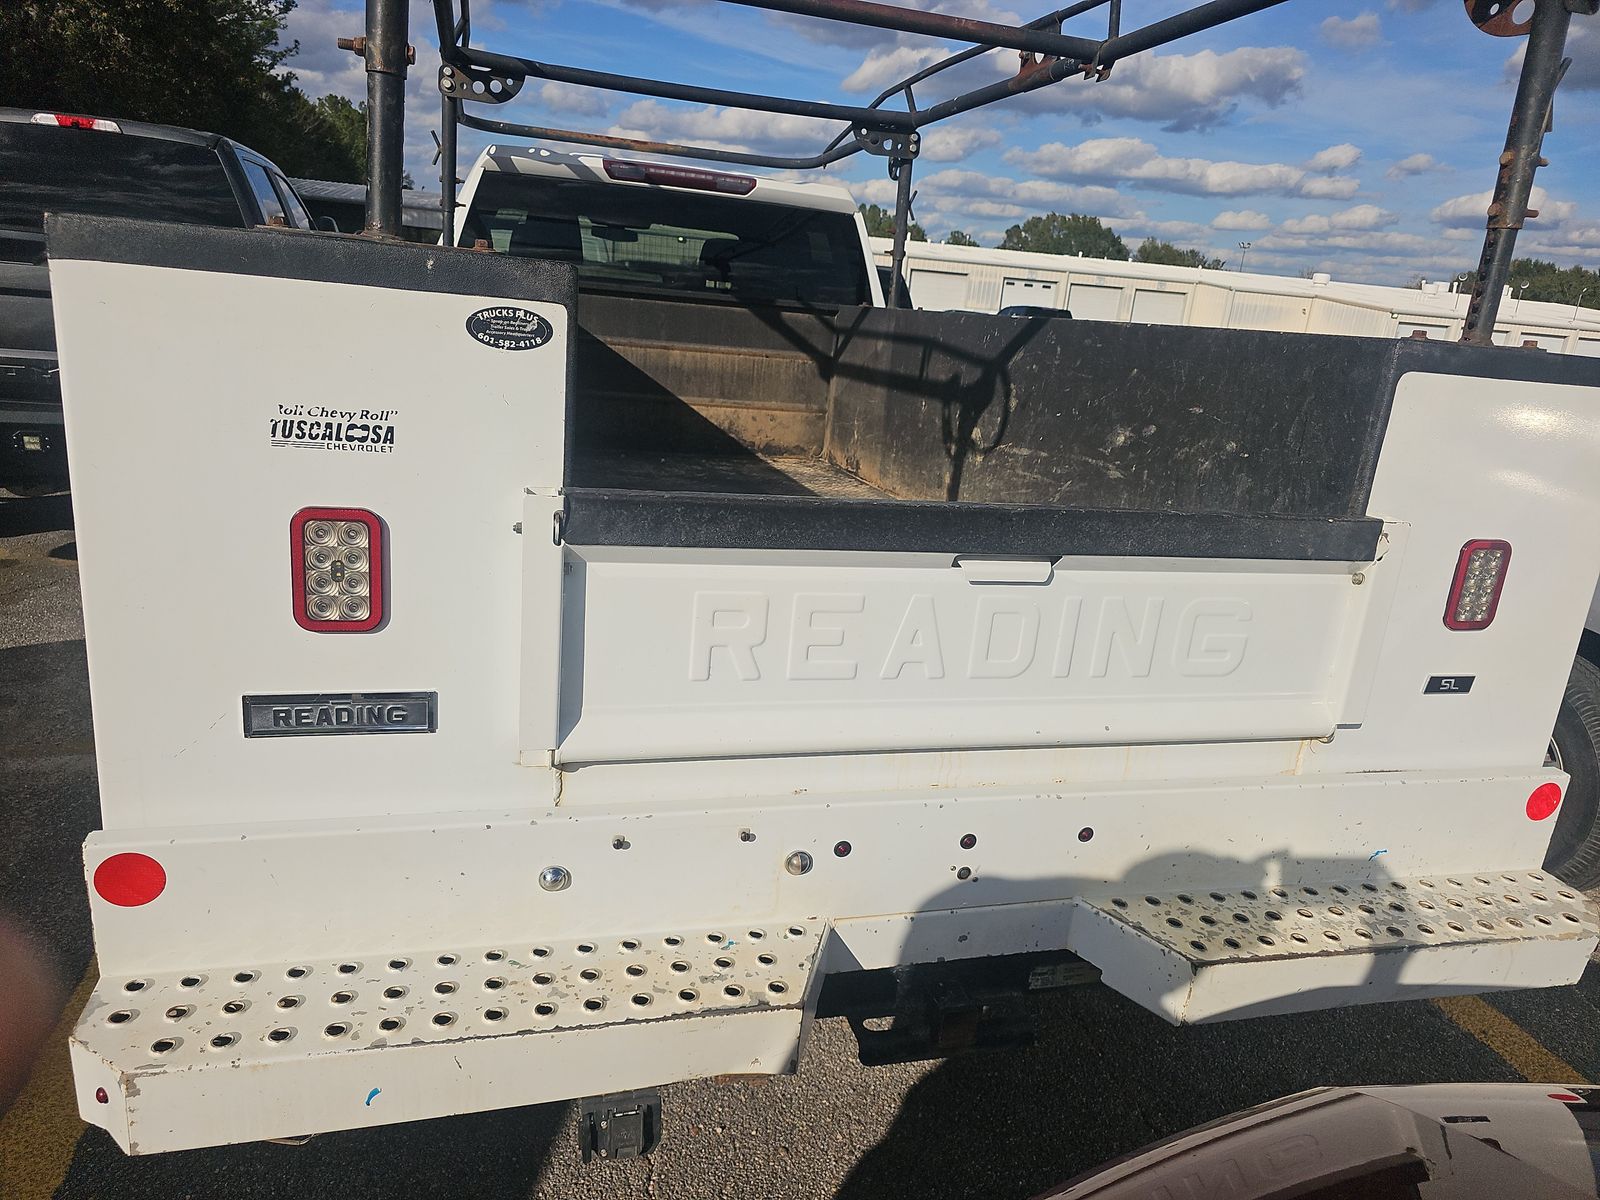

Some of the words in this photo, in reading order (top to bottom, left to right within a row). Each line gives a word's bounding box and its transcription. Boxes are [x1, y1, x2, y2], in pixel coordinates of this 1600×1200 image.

[477, 309, 513, 321] TRUCKS
[516, 310, 539, 322] PLUS
[477, 332, 542, 348] 601-582-4118
[307, 406, 357, 422] Chevy
[269, 418, 395, 444] TUSCALOOSA
[326, 442, 394, 453] CHEVROLET
[689, 591, 1254, 681] READING
[1439, 678, 1459, 690] SL
[272, 705, 408, 728] READING
